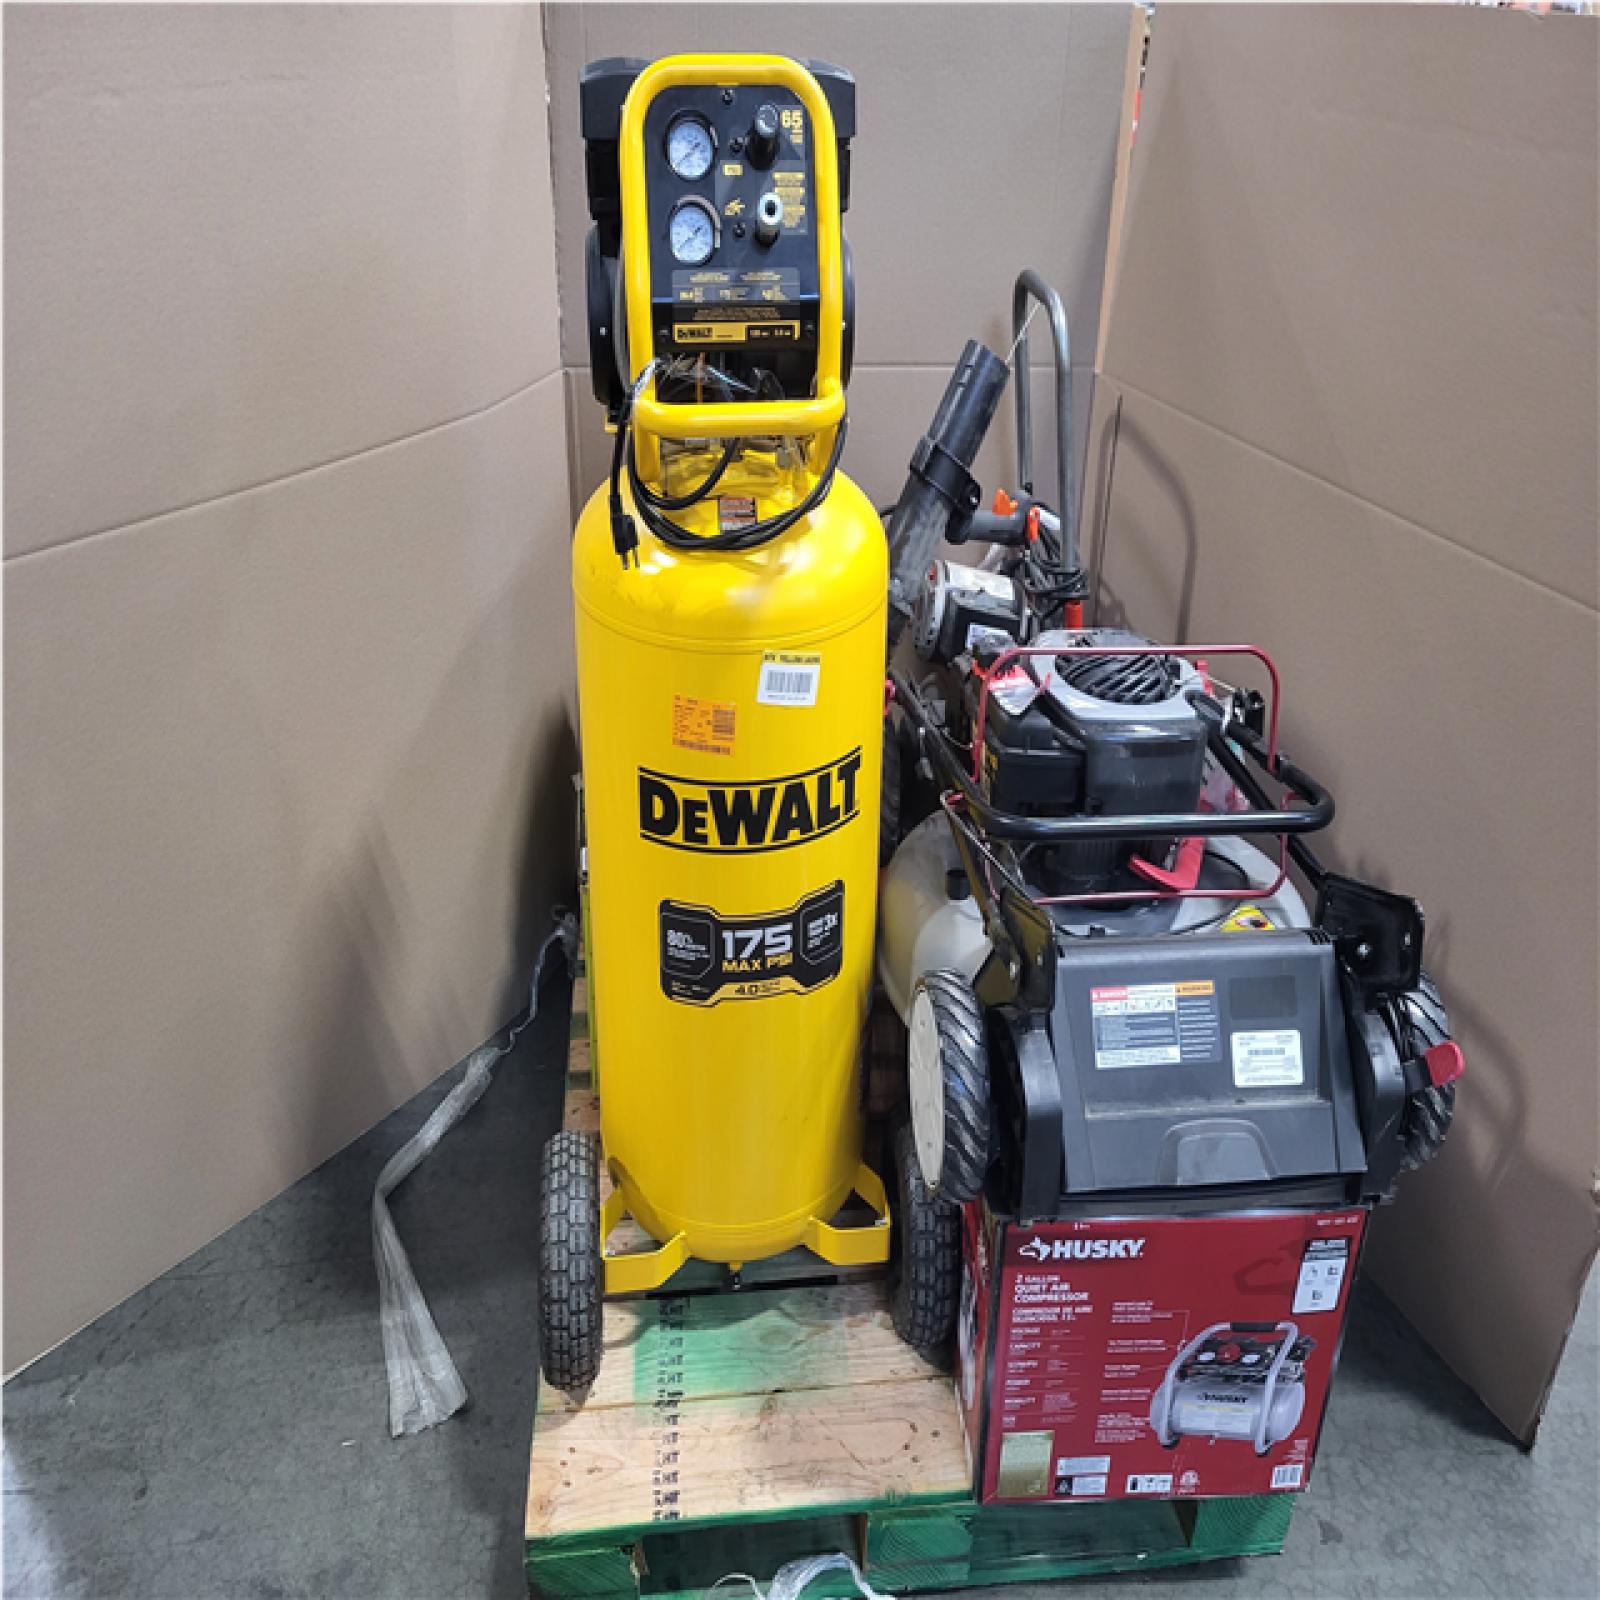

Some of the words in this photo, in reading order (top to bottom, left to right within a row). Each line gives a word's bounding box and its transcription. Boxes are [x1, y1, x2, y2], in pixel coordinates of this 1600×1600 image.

[781, 109, 803, 129] 65
[721, 922, 794, 959] 175
[721, 959, 761, 972] MAX
[766, 952, 793, 969] PSI
[1052, 1239, 1146, 1259] HUSKY
